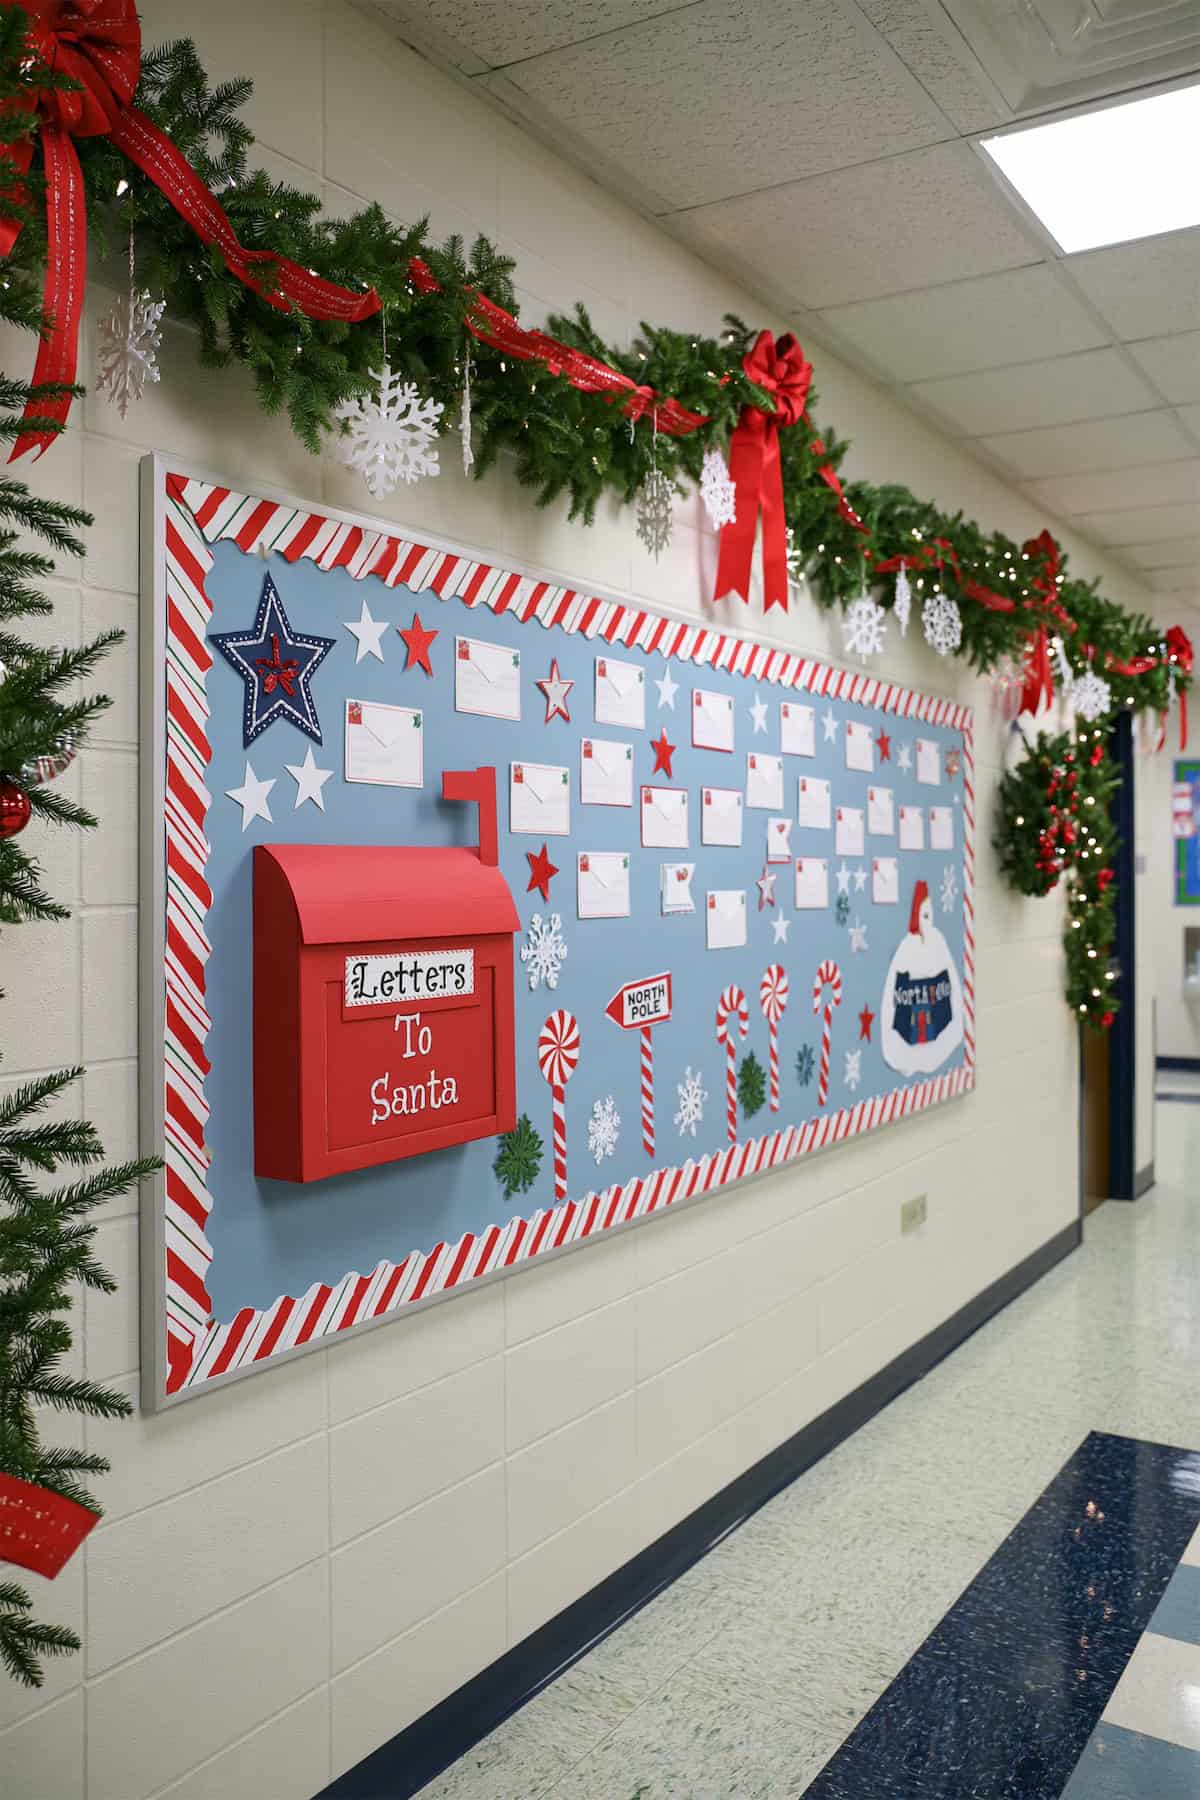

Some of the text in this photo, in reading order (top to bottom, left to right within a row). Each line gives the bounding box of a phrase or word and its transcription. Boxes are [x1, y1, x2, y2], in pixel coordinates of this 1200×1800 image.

[351, 960, 465, 998] Letters
[628, 984, 664, 1006] NORTH
[631, 1000, 660, 1020] POLE
[394, 1013, 432, 1058] To
[370, 1069, 459, 1125] Santa
